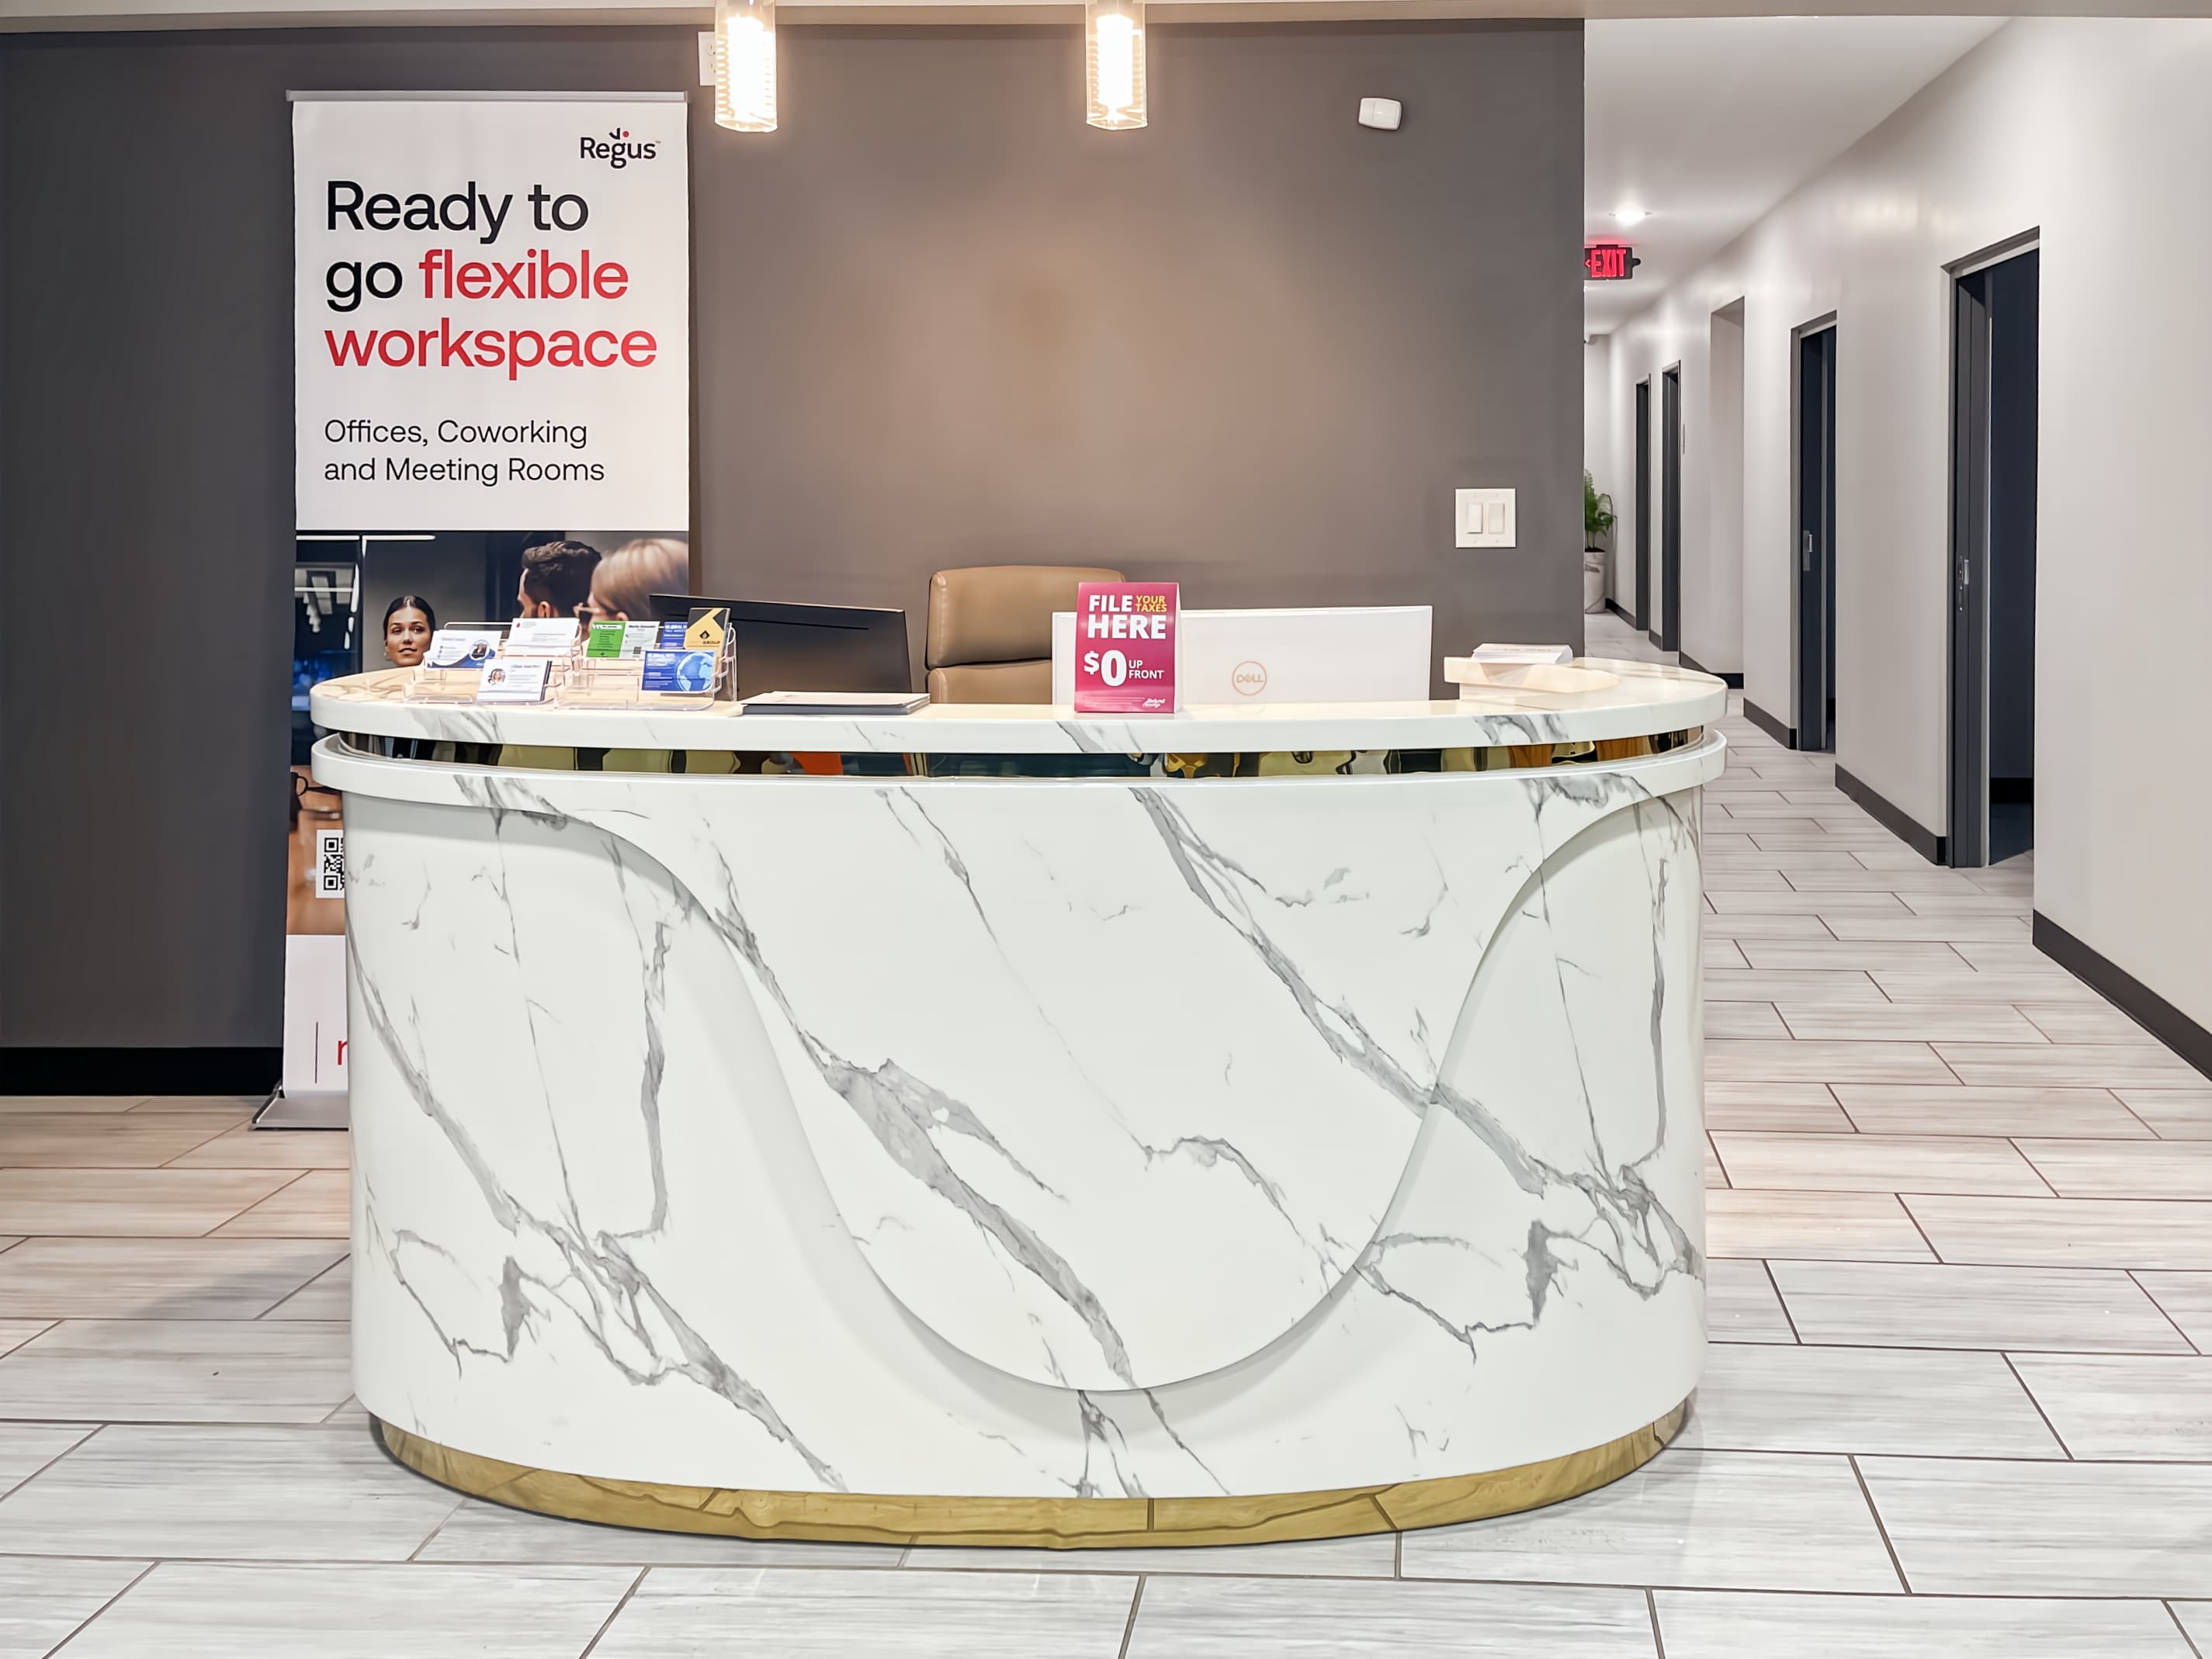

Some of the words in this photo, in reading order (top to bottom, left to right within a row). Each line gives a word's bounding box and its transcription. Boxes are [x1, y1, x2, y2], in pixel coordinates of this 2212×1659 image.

[579, 132, 657, 169] Regus
[326, 180, 513, 244] Ready
[527, 183, 589, 232] to
[1591, 248, 1626, 278] EXIT
[325, 259, 404, 313] go
[418, 248, 629, 300] flexible
[323, 317, 657, 381] workspace
[324, 418, 429, 447] Offices,
[437, 420, 588, 449] Coworking
[324, 458, 376, 481] and
[387, 458, 498, 487] Meeting
[508, 458, 605, 481] Rooms
[1088, 594, 1133, 612] FILE
[1135, 595, 1166, 604] YOUR
[1135, 603, 1167, 612] TAXES
[1087, 614, 1167, 639] HERE
[1083, 649, 1127, 687] $0
[1129, 660, 1143, 669] UP
[1129, 670, 1164, 680] FRONT
[1236, 674, 1265, 683] DELL
